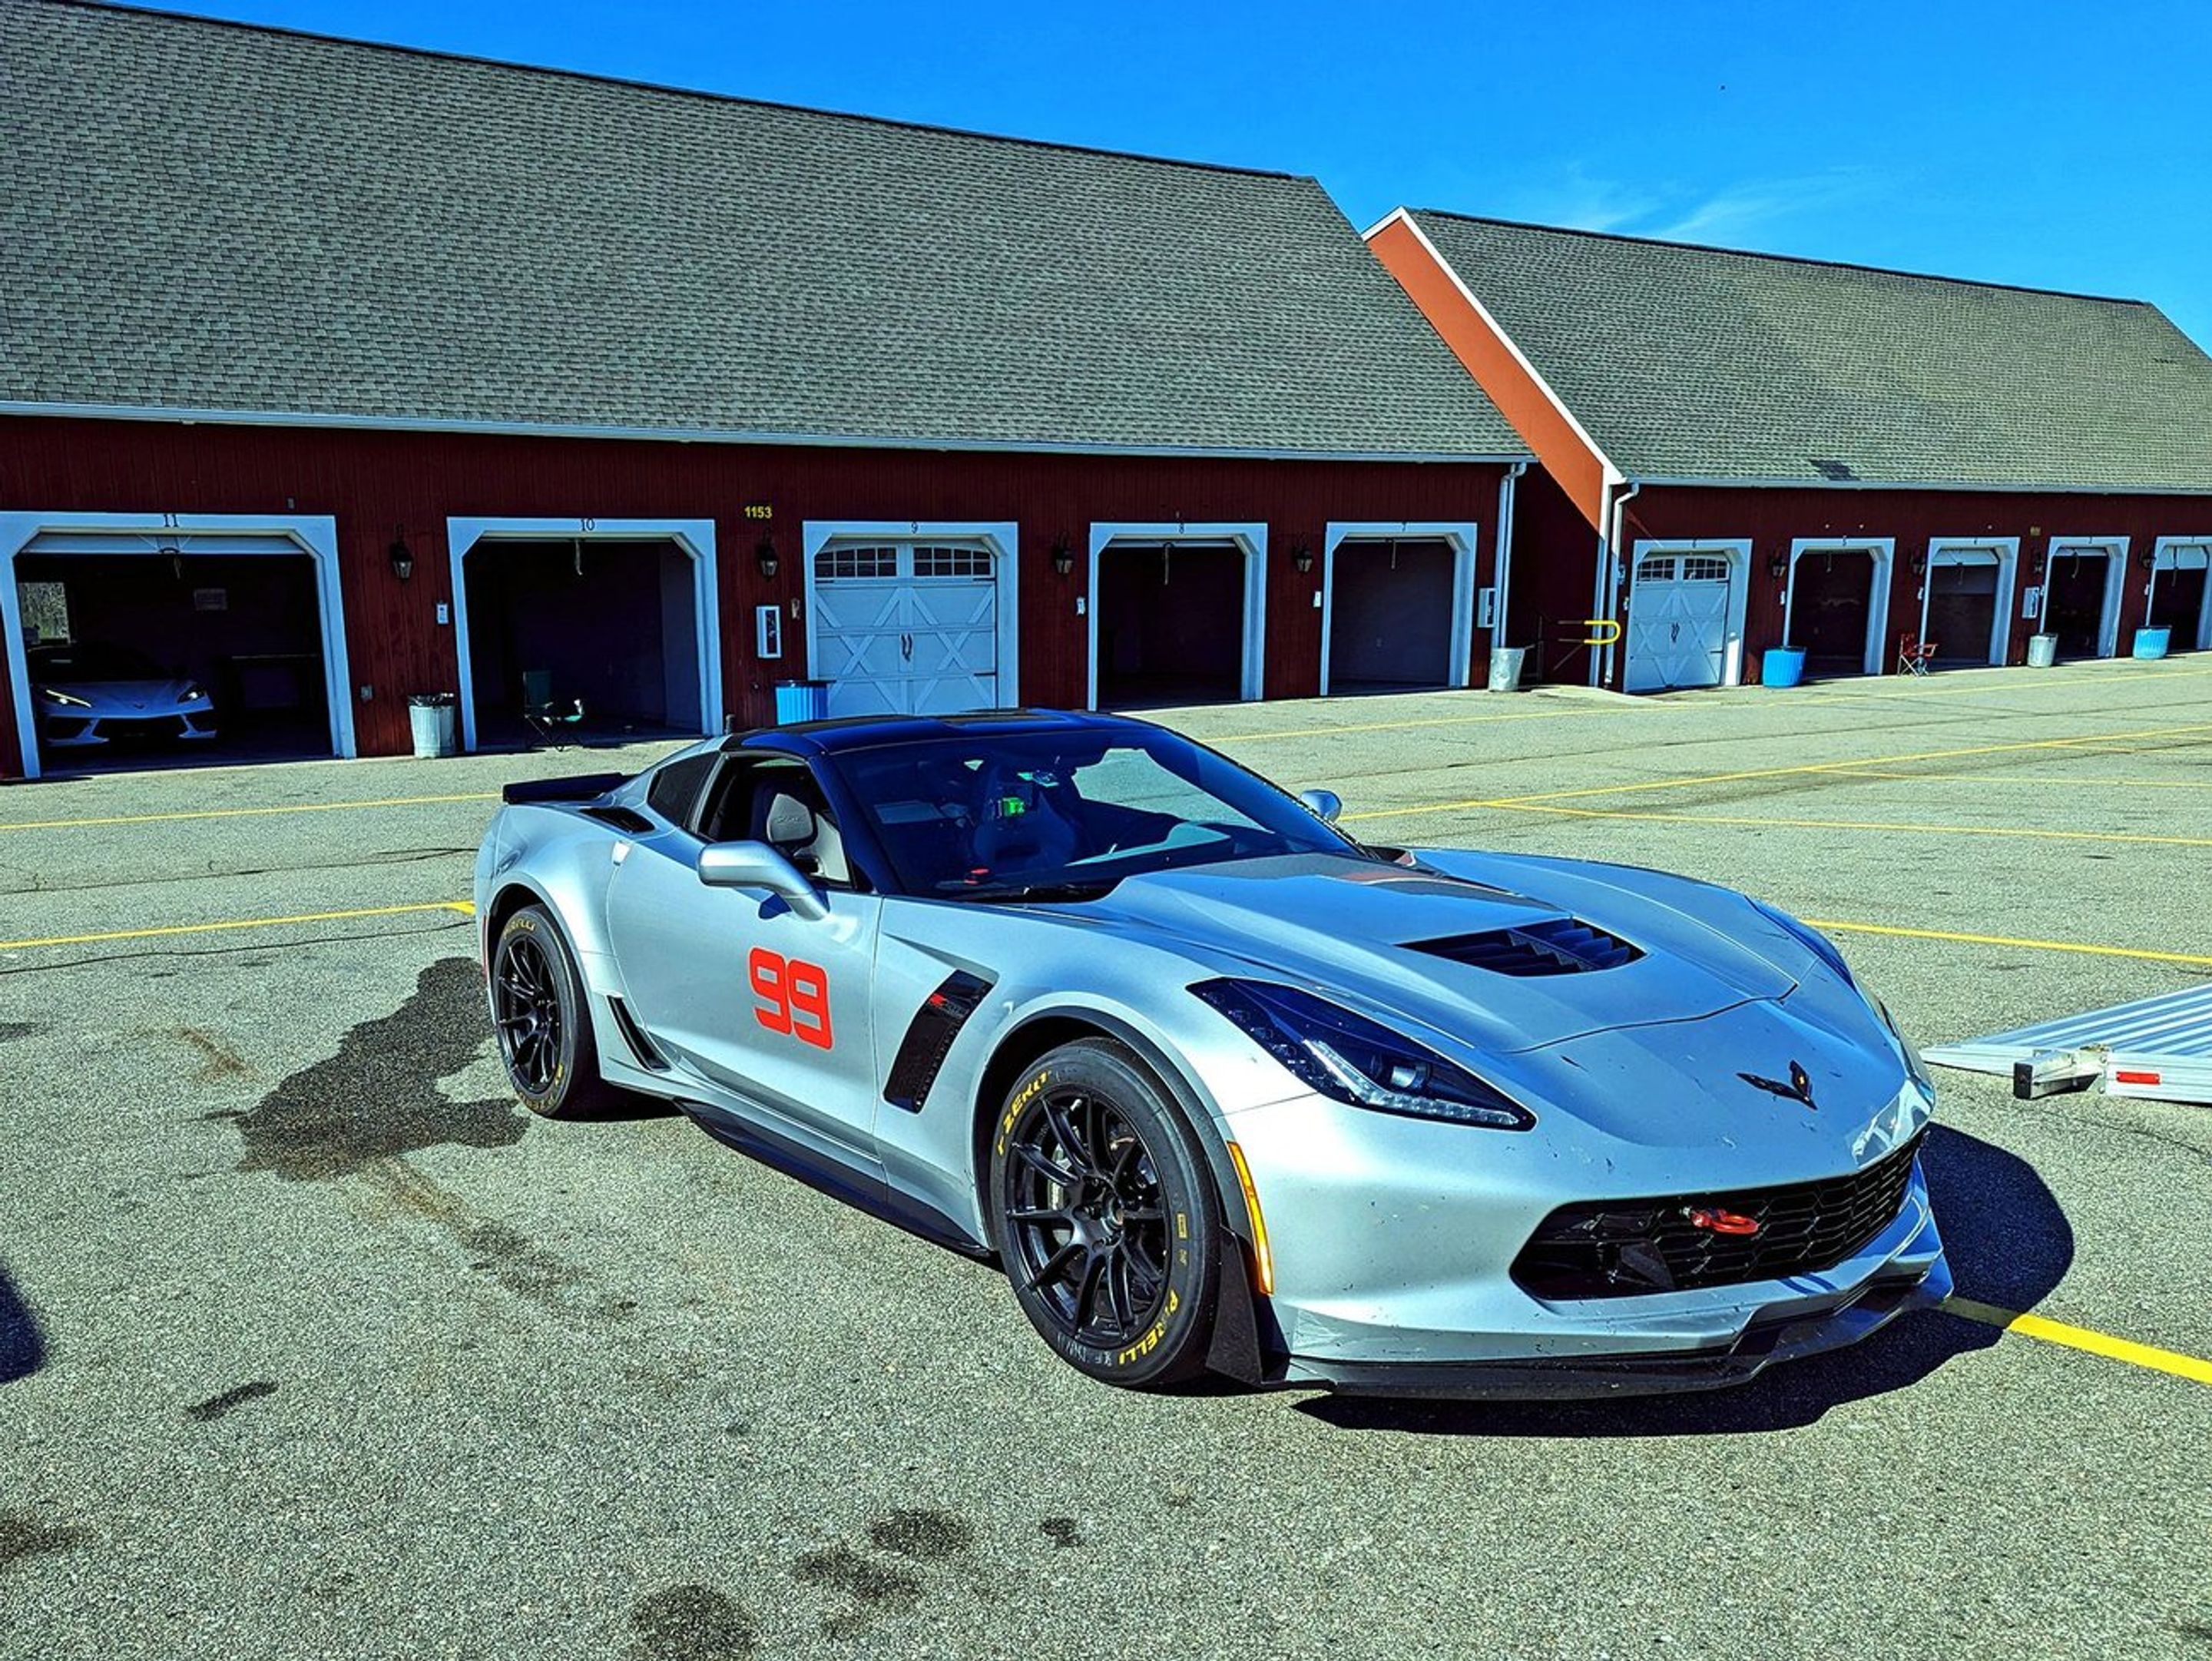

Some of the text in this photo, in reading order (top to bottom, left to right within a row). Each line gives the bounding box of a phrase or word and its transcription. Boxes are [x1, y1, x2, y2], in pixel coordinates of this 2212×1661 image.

[744, 506, 773, 519] 1153
[164, 514, 178, 527] 11
[581, 519, 595, 531] 10
[911, 522, 919, 534] 9
[749, 947, 834, 1052] 99
